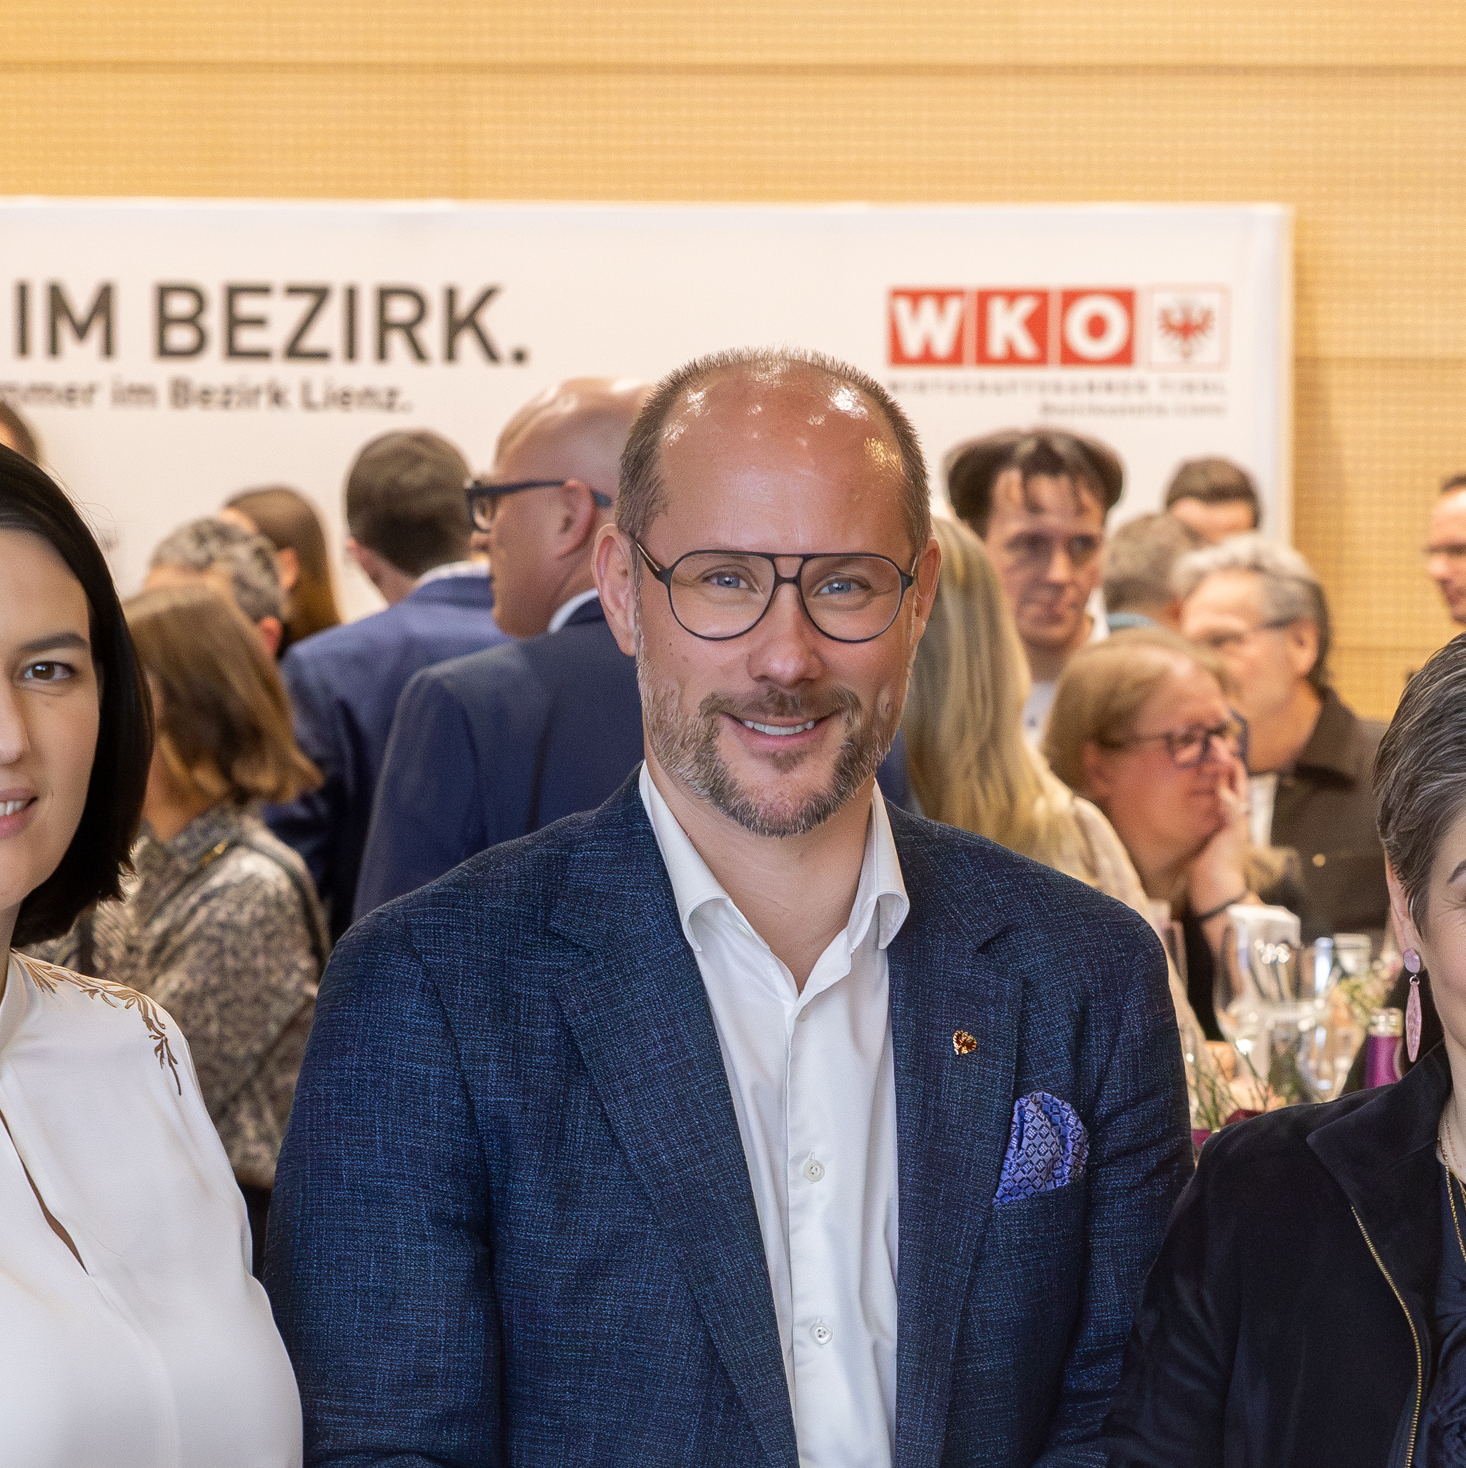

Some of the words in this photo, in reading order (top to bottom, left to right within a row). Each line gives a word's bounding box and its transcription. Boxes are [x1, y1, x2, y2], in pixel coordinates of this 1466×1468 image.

[13, 278, 117, 360] IM
[153, 280, 530, 366] BEZIRK.
[890, 291, 1132, 363] WKO
[111, 373, 158, 410] im
[168, 376, 290, 411] Bezirk
